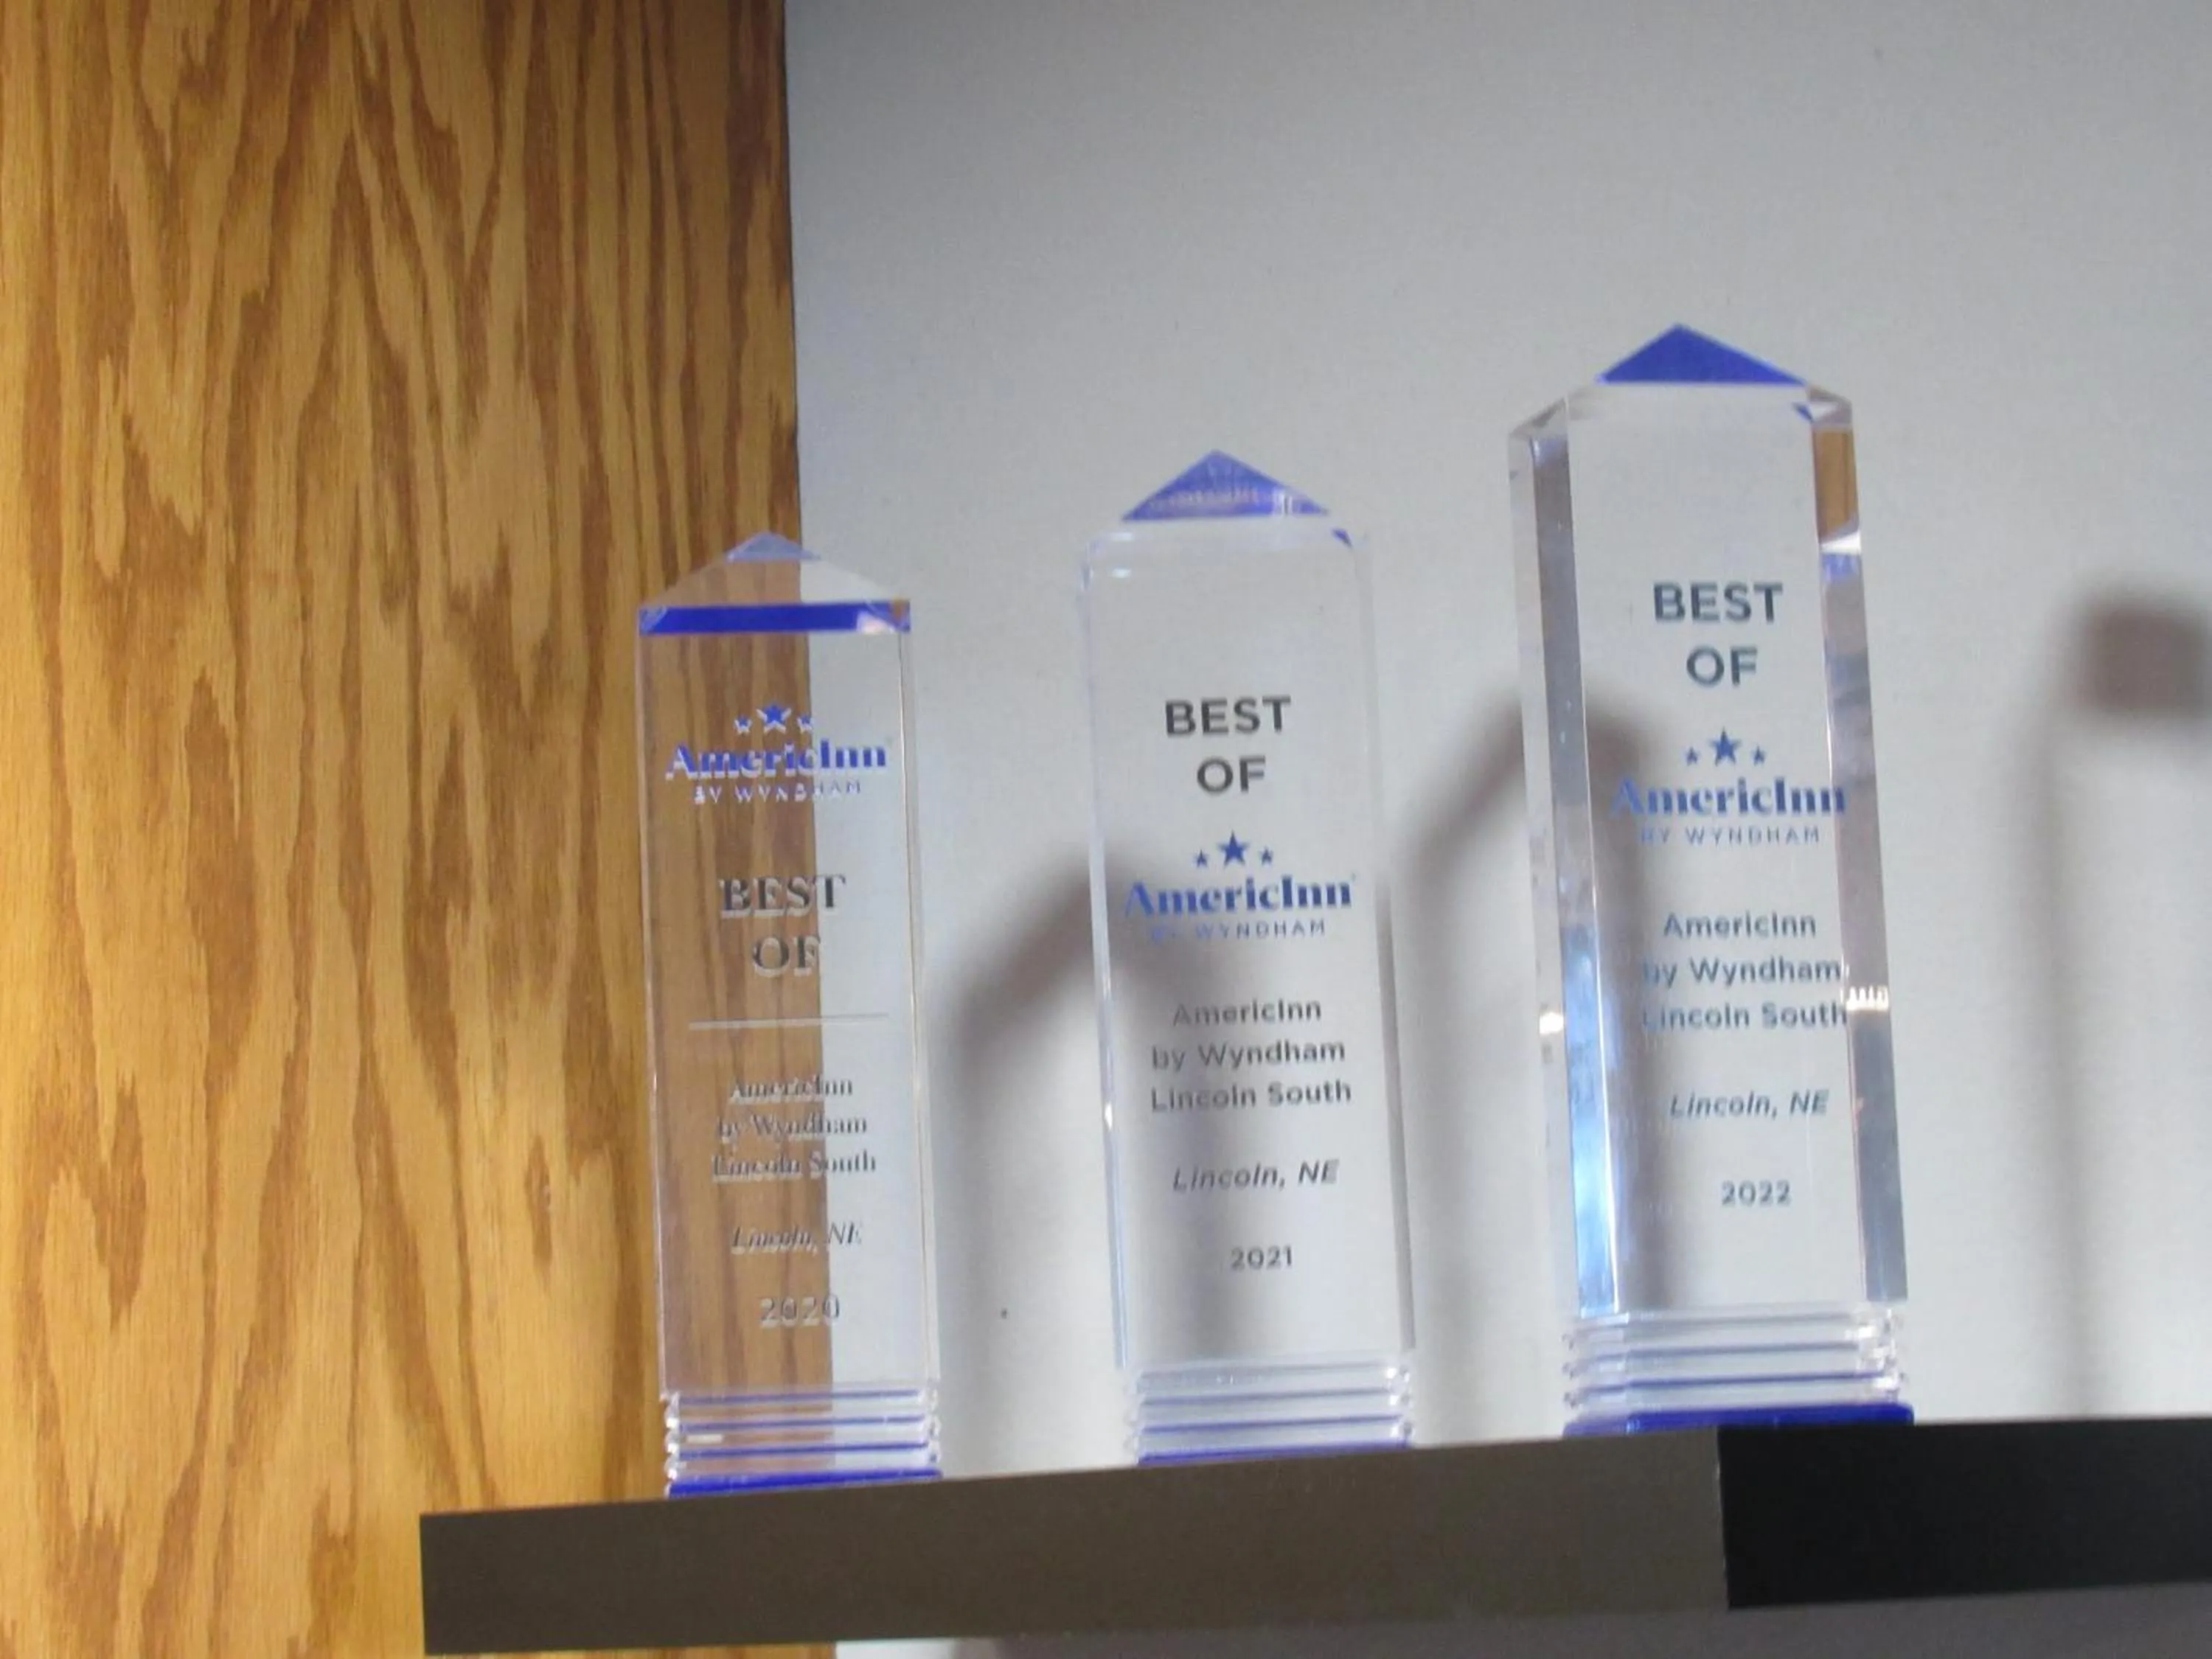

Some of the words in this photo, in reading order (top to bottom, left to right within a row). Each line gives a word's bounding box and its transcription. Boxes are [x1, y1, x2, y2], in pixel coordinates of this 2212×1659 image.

[1653, 581, 1784, 625] BEST
[1686, 644, 1759, 688] OF
[1164, 695, 1292, 737] BEST
[666, 740, 887, 781] AmericInn
[1196, 754, 1266, 796] OF
[1610, 776, 1848, 820] AmericInn
[1685, 825, 1820, 846] WYNDHAM
[718, 873, 846, 919] BEST
[1124, 874, 1353, 919] AmericInn
[1195, 919, 1327, 942] WYNDHAM
[1663, 911, 1817, 940] AmericInn
[752, 933, 821, 978] OF
[1644, 960, 1678, 989] by
[1688, 954, 1840, 987] Wyndham
[1172, 998, 1322, 1027] AmericInn
[1643, 1002, 1750, 1032] Lincoln
[1761, 1001, 1848, 1029] South
[1151, 1046, 1186, 1071] by
[1197, 1038, 1346, 1071] Wyndham
[1151, 1084, 1257, 1113] Lincoln
[1267, 1079, 1352, 1107] South
[1669, 1091, 1778, 1120] Lincoln,
[1789, 1090, 1829, 1115] NE
[750, 1113, 868, 1144] Wyndham
[809, 1149, 876, 1178] South
[1171, 1162, 1286, 1193] Lincoln,
[1298, 1158, 1340, 1184] NE
[1721, 1181, 1792, 1208] 2022
[1231, 1245, 1294, 1271] 2021
[759, 1294, 842, 1328] 2020
